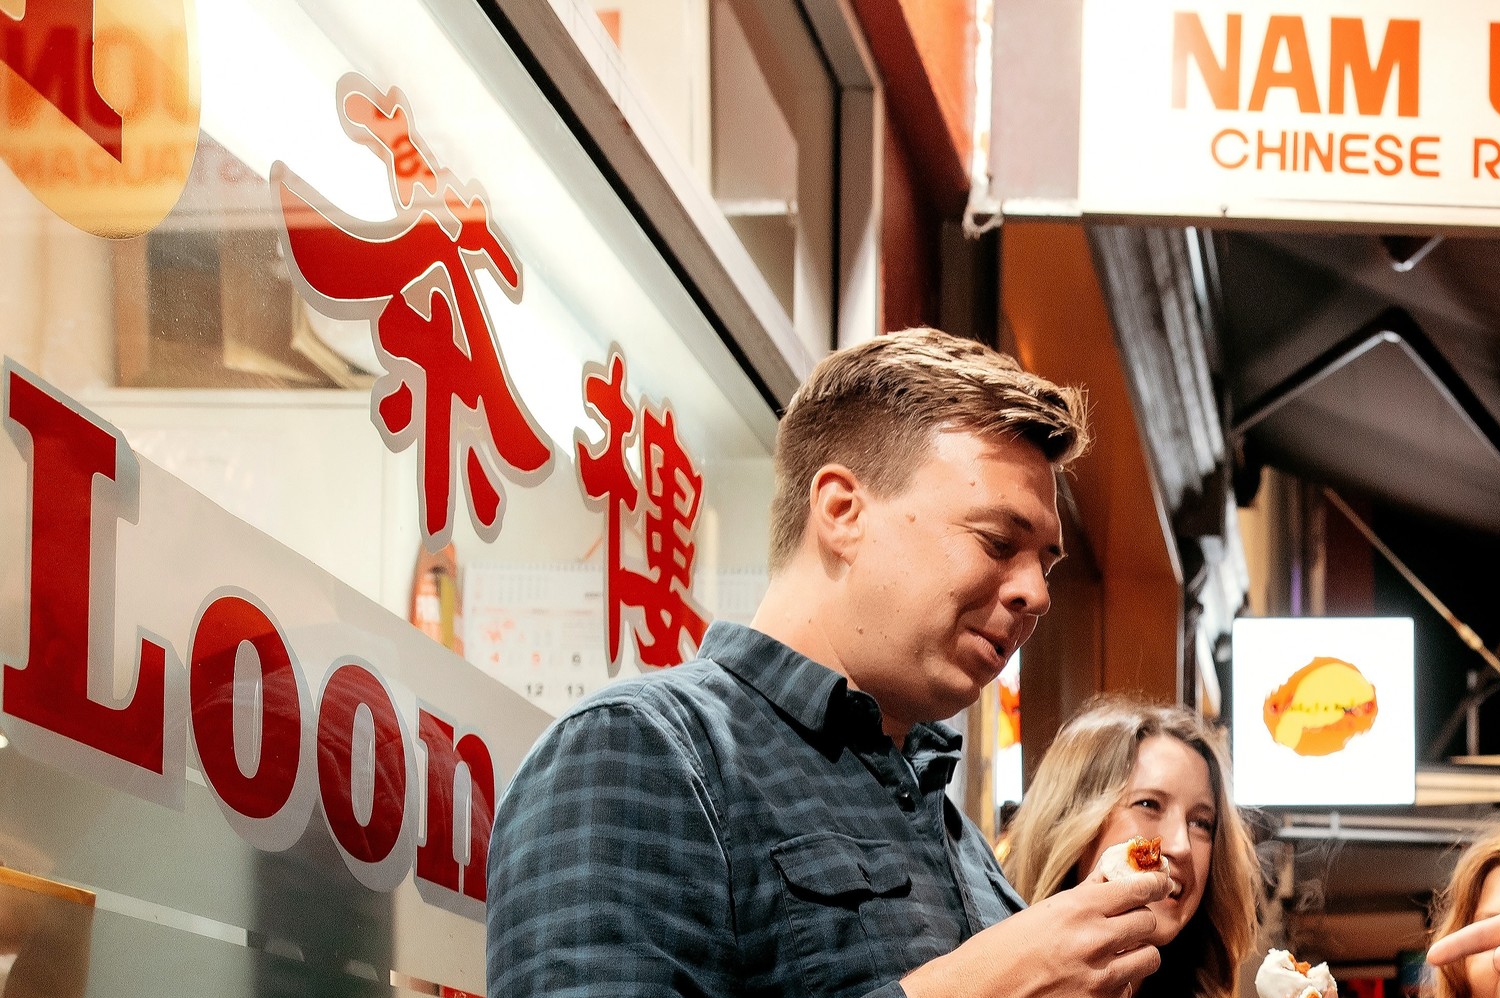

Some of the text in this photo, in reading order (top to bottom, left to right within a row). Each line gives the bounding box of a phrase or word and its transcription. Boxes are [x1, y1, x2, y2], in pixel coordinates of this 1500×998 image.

[1171, 12, 1421, 118] NAM
[1211, 128, 1440, 179] CHINESE
[526, 684, 585, 698] 12 13
